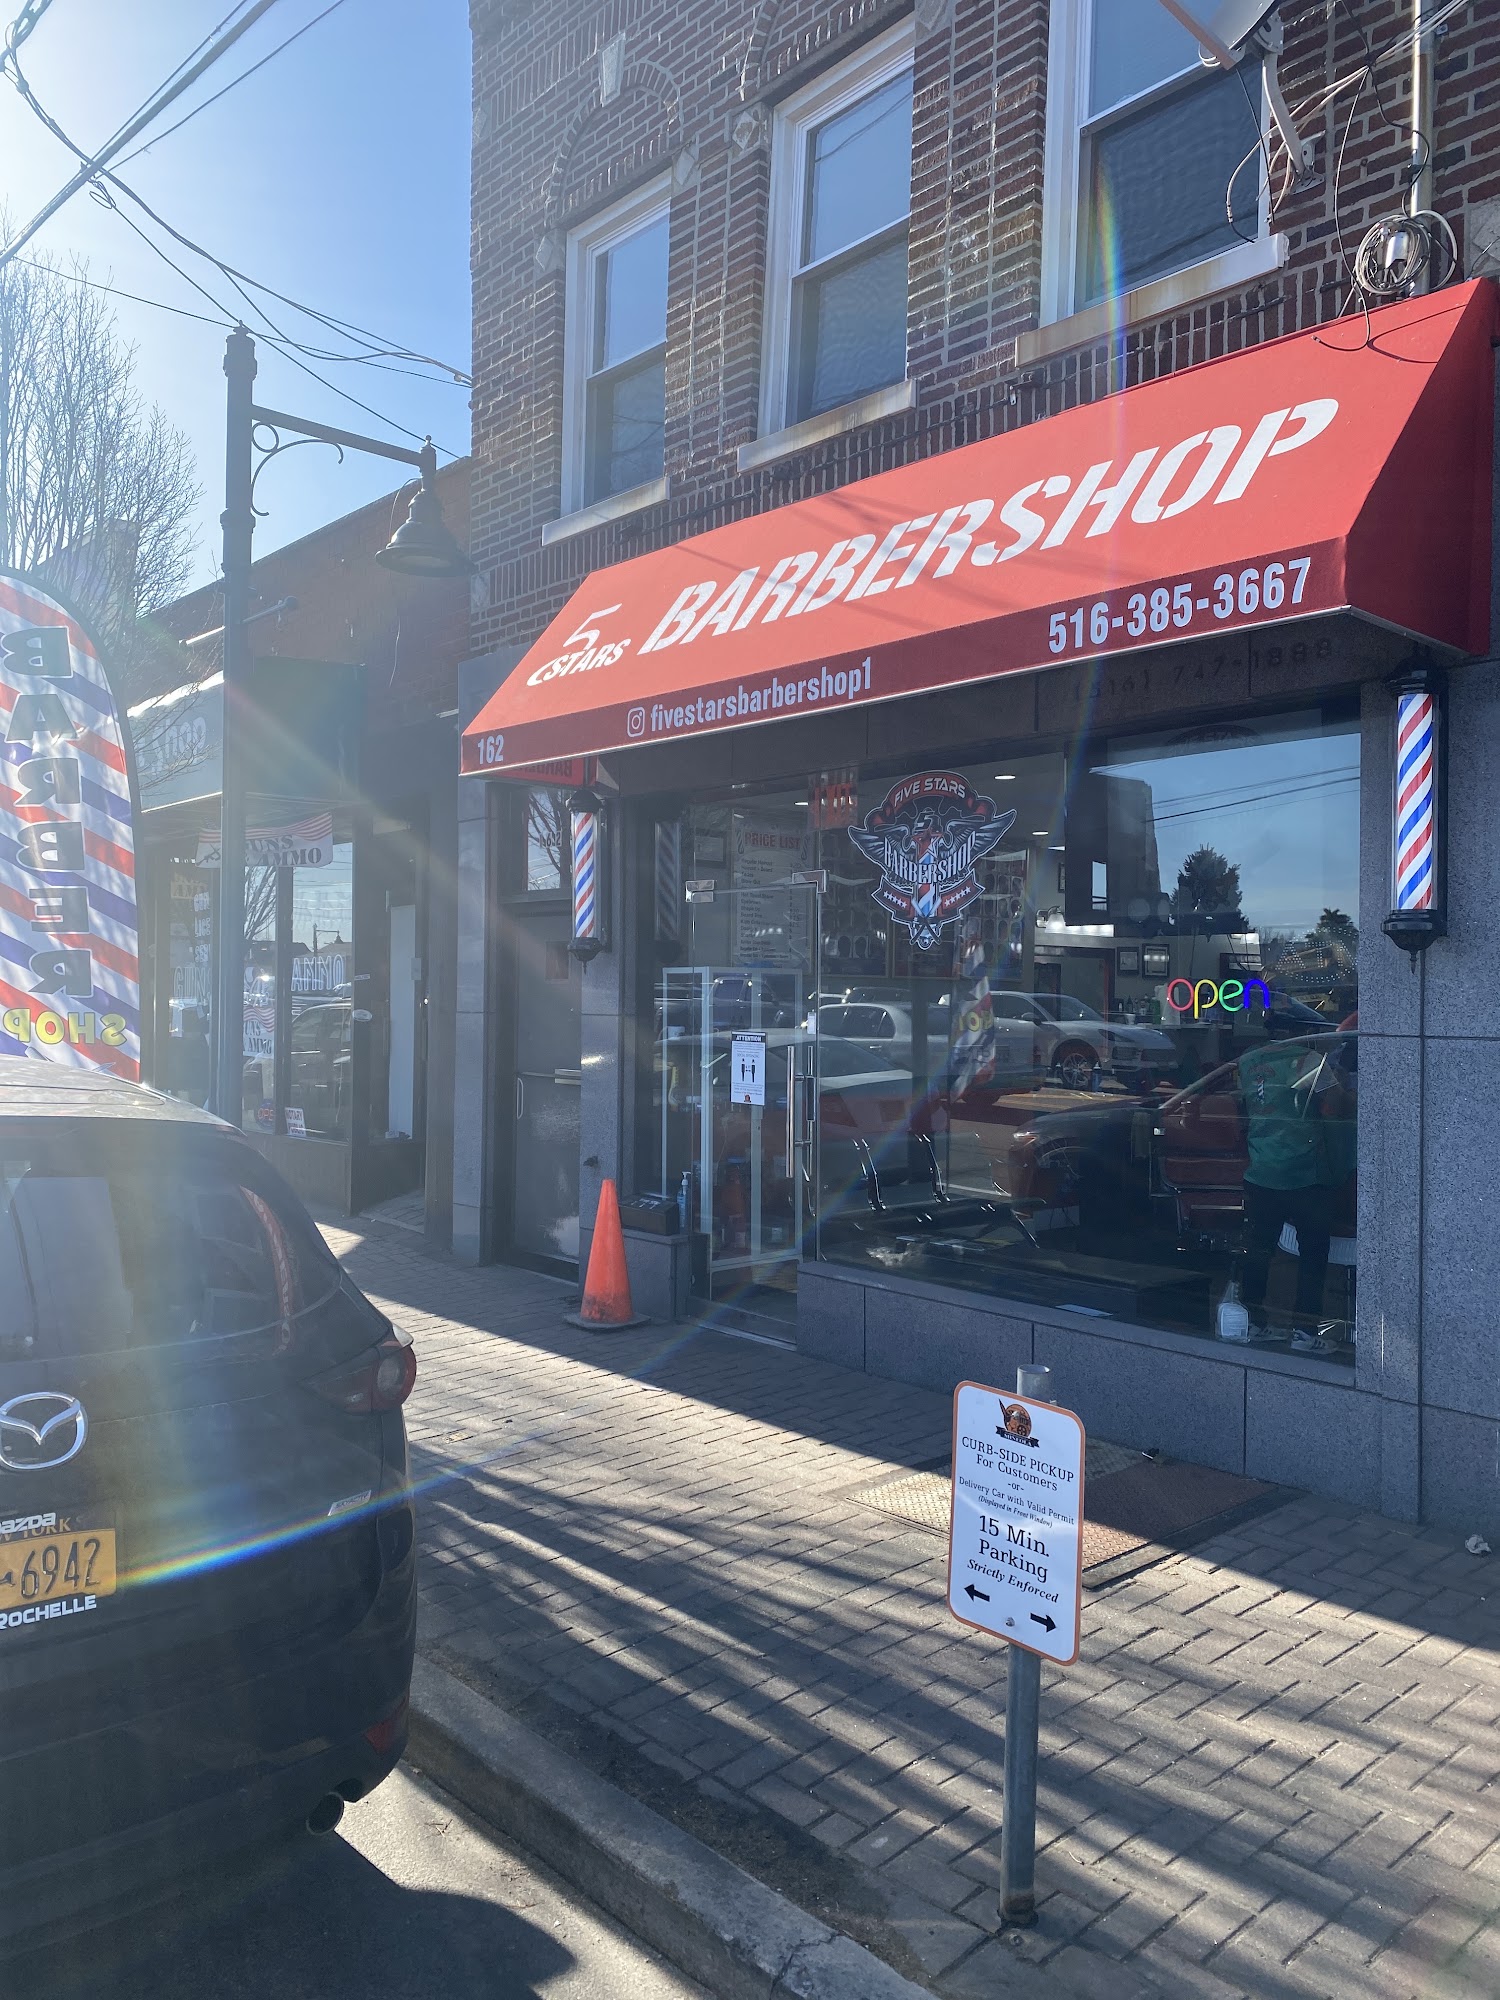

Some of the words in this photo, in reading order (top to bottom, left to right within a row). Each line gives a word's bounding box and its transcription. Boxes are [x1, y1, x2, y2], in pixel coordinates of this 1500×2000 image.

[637, 398, 1339, 656] BARBERSHOP
[1048, 557, 1313, 654] 516-385-3667
[542, 638, 632, 682] STARS
[650, 656, 873, 732] fivestarsbarbershop1
[477, 735, 504, 765] 162
[894, 780, 921, 807] FIVE
[924, 777, 966, 799] STARS
[256, 846, 322, 866] AMMO
[745, 832, 776, 848] PRICE
[779, 834, 801, 850] LIST
[884, 830, 976, 884] BARBERSHOP
[257, 1107, 275, 1122] OPE
[961, 1436, 1027, 1467] CURB-SIDE
[1029, 1458, 1075, 1483] PICKUP
[976, 1454, 994, 1469] For
[997, 1461, 1058, 1492] Customers
[959, 1476, 990, 1496] Delivery
[991, 1488, 1005, 1499] Car
[1007, 1494, 1025, 1506] with
[1027, 1500, 1046, 1514] Valid
[1048, 1508, 1075, 1525] Permit
[978, 1495, 1006, 1511] (Displayed
[1013, 1507, 1029, 1519] Front
[1029, 1513, 1053, 1528] Window)
[0, 1512, 57, 1534] azda
[979, 1515, 1000, 1537] 15
[1006, 1523, 1050, 1557] Min.
[21, 1538, 101, 1598] 6942
[967, 1559, 1006, 1582] Strictly
[1008, 1575, 1059, 1604] Enforced
[978, 1538, 1049, 1583] Parking
